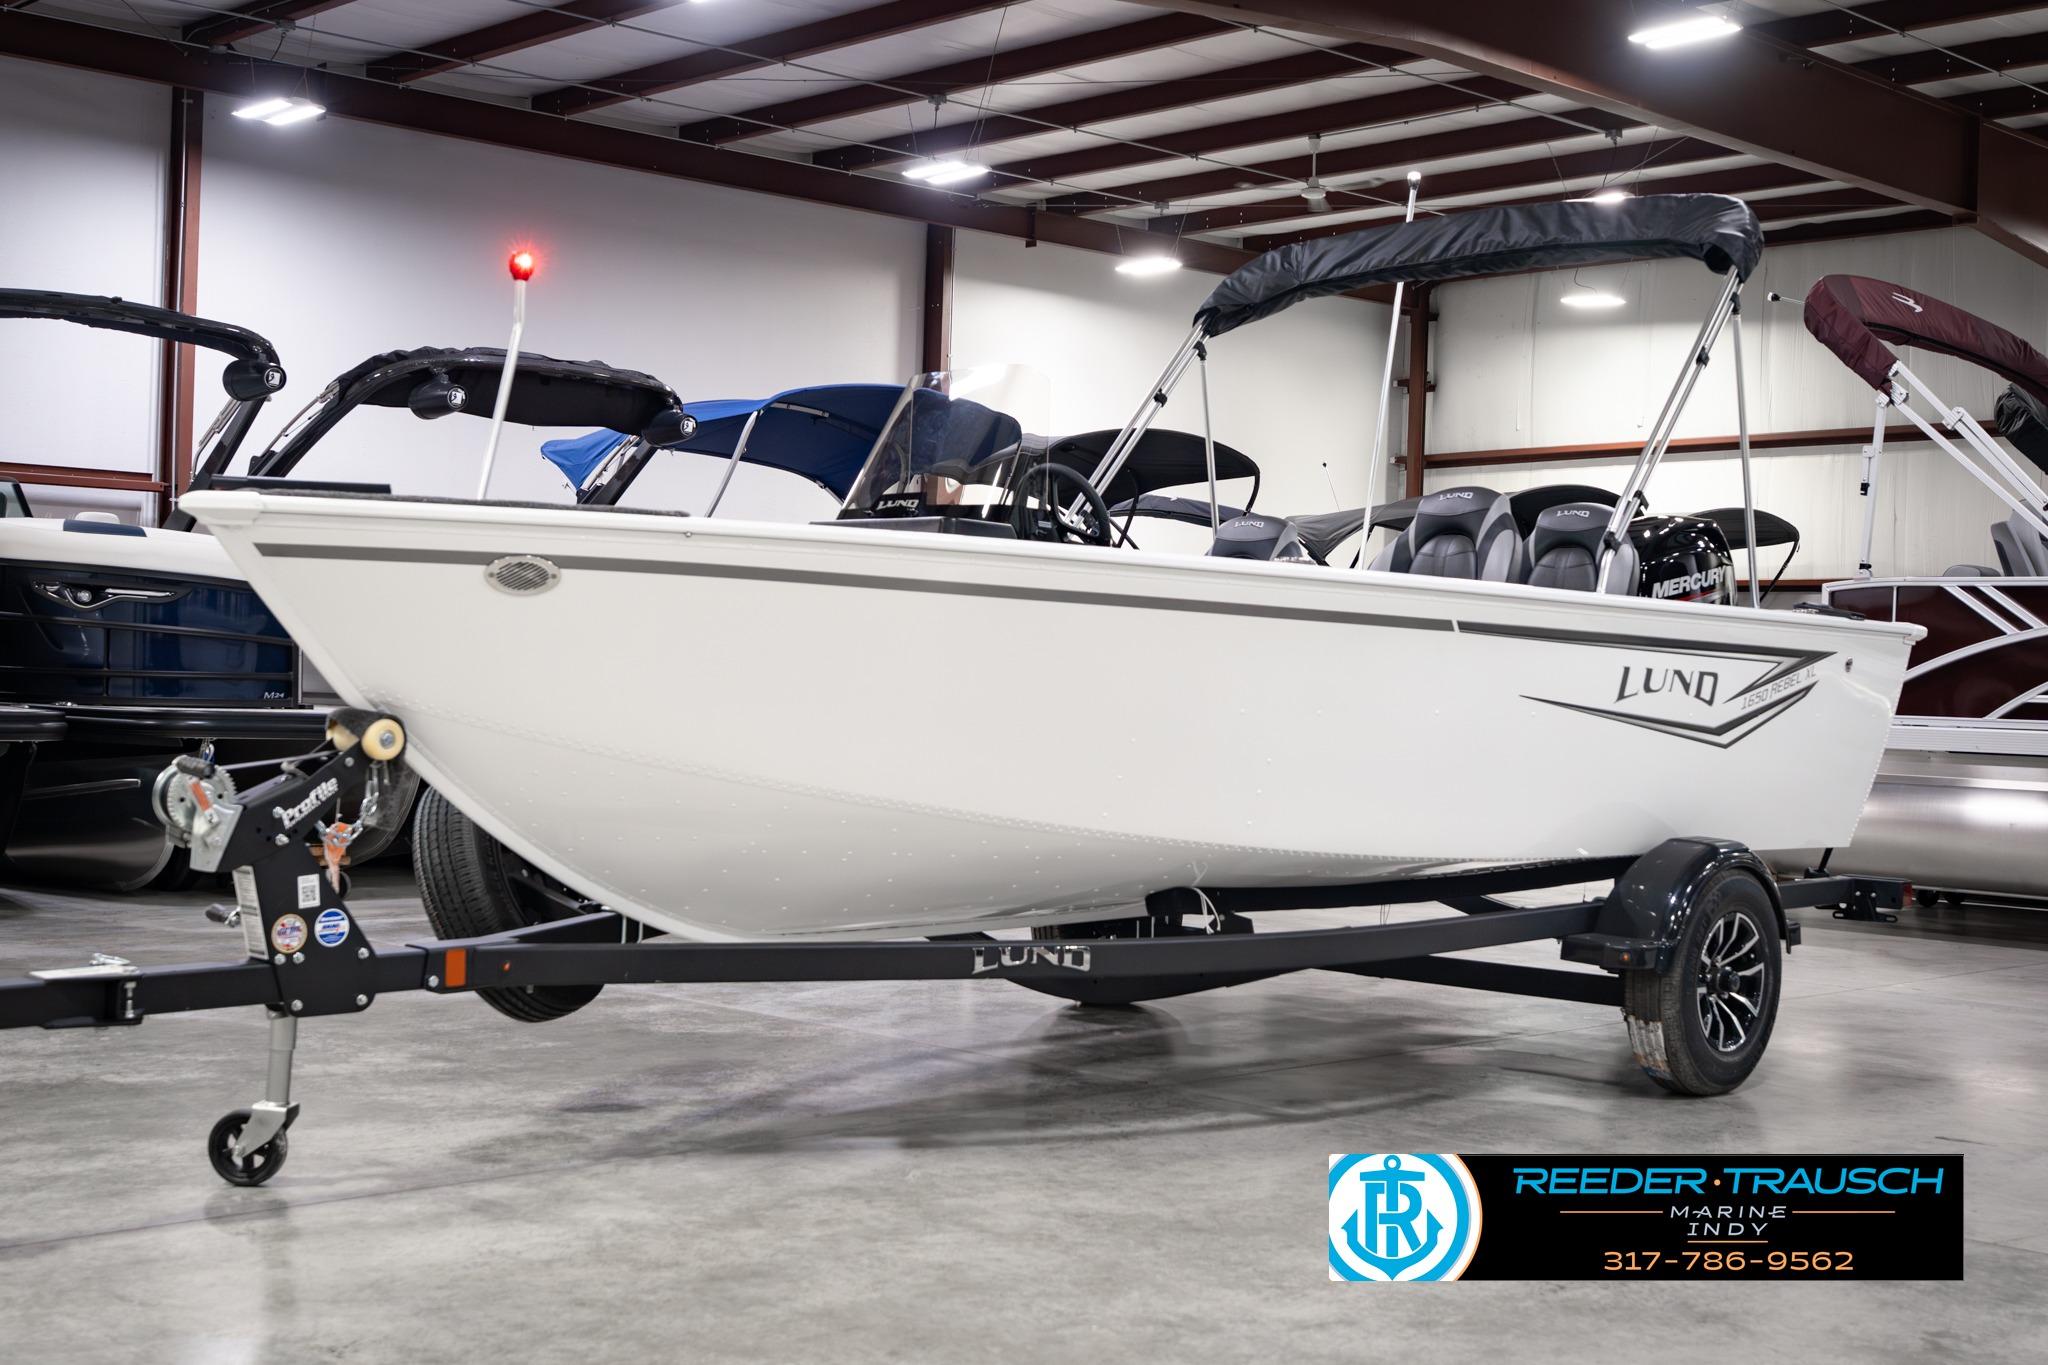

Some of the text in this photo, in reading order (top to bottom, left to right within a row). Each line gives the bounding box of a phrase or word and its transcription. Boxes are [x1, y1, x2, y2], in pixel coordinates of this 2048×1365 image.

[876, 499, 920, 511] LUND
[1439, 491, 1474, 501] LUND
[1234, 520, 1264, 528] LUND
[1556, 509, 1590, 518] LUND
[1652, 565, 1725, 599] MERCURY
[1614, 666, 1719, 707] LUND
[1741, 688, 1769, 710] 1650
[1769, 671, 1802, 700] REBEL
[281, 777, 338, 830] Profile
[972, 945, 1091, 975] LUND
